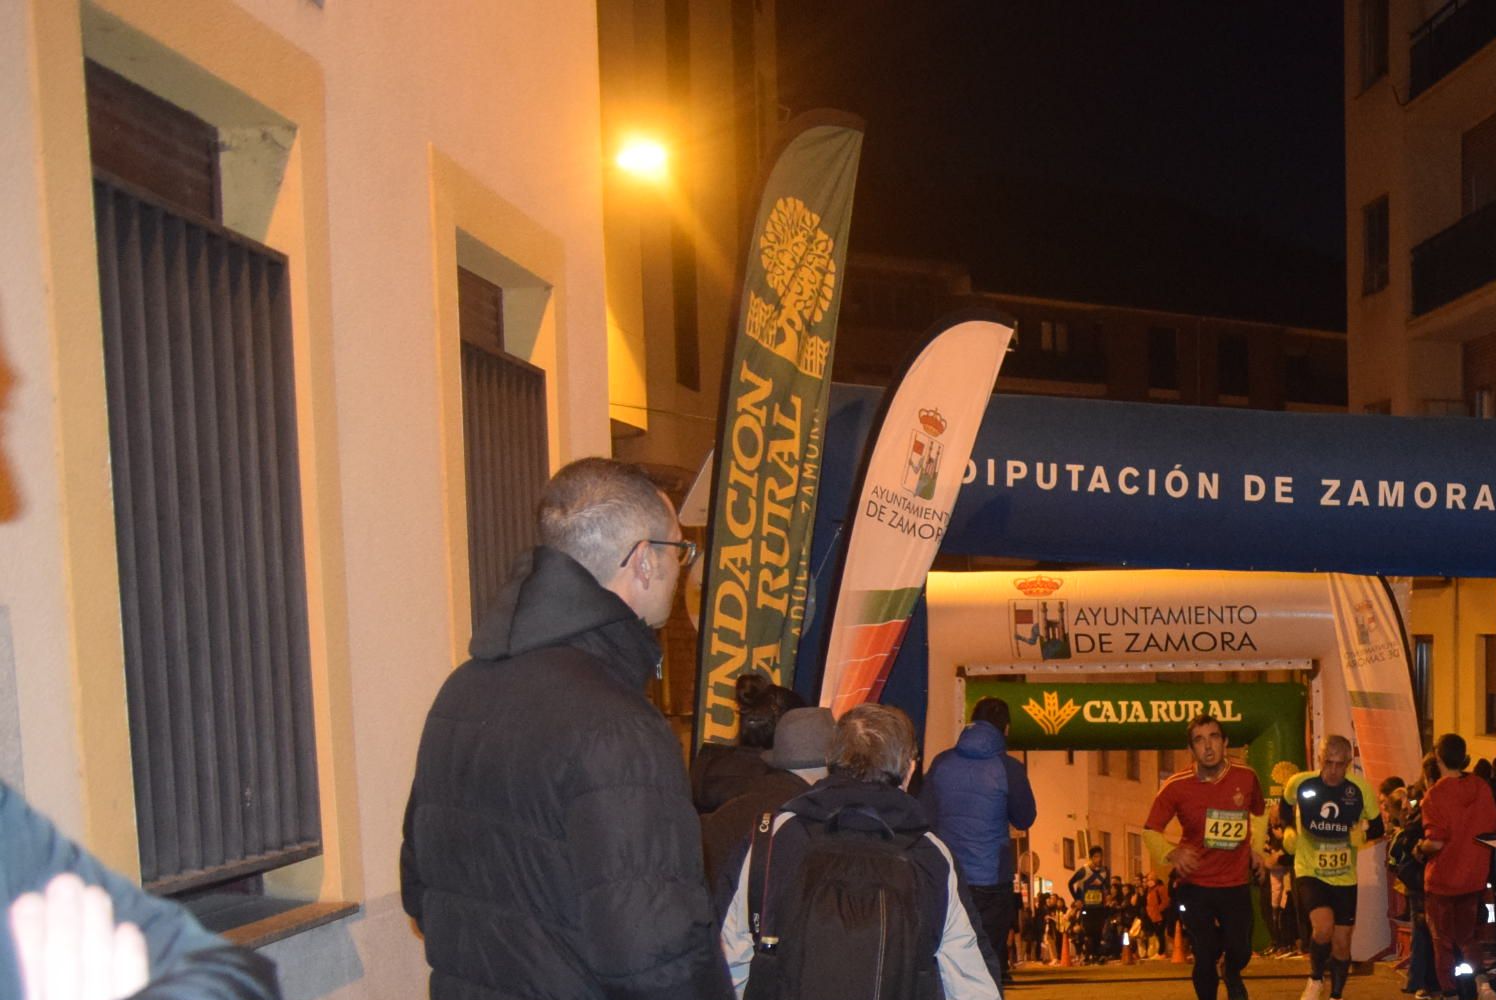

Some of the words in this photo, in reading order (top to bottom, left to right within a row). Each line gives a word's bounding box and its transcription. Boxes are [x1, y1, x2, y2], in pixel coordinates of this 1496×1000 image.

[1244, 474, 1294, 503] DE
[1320, 479, 1496, 511] ZAMORA
[757, 395, 802, 617] RURAL
[871, 486, 949, 524] AYUNTAMIENT
[866, 500, 887, 522] DE
[888, 510, 943, 542] ZAMOR
[704, 360, 773, 741] UNDACION
[1074, 605, 1257, 626] AYUNTAMIENTO
[1075, 632, 1113, 653] DE
[1125, 631, 1257, 653] ZAMORA
[1083, 700, 1149, 724] CAJA
[1150, 700, 1242, 722] RURAL
[1209, 821, 1244, 838] 422
[1309, 820, 1348, 832] Adarsa
[1318, 852, 1348, 868] 539
